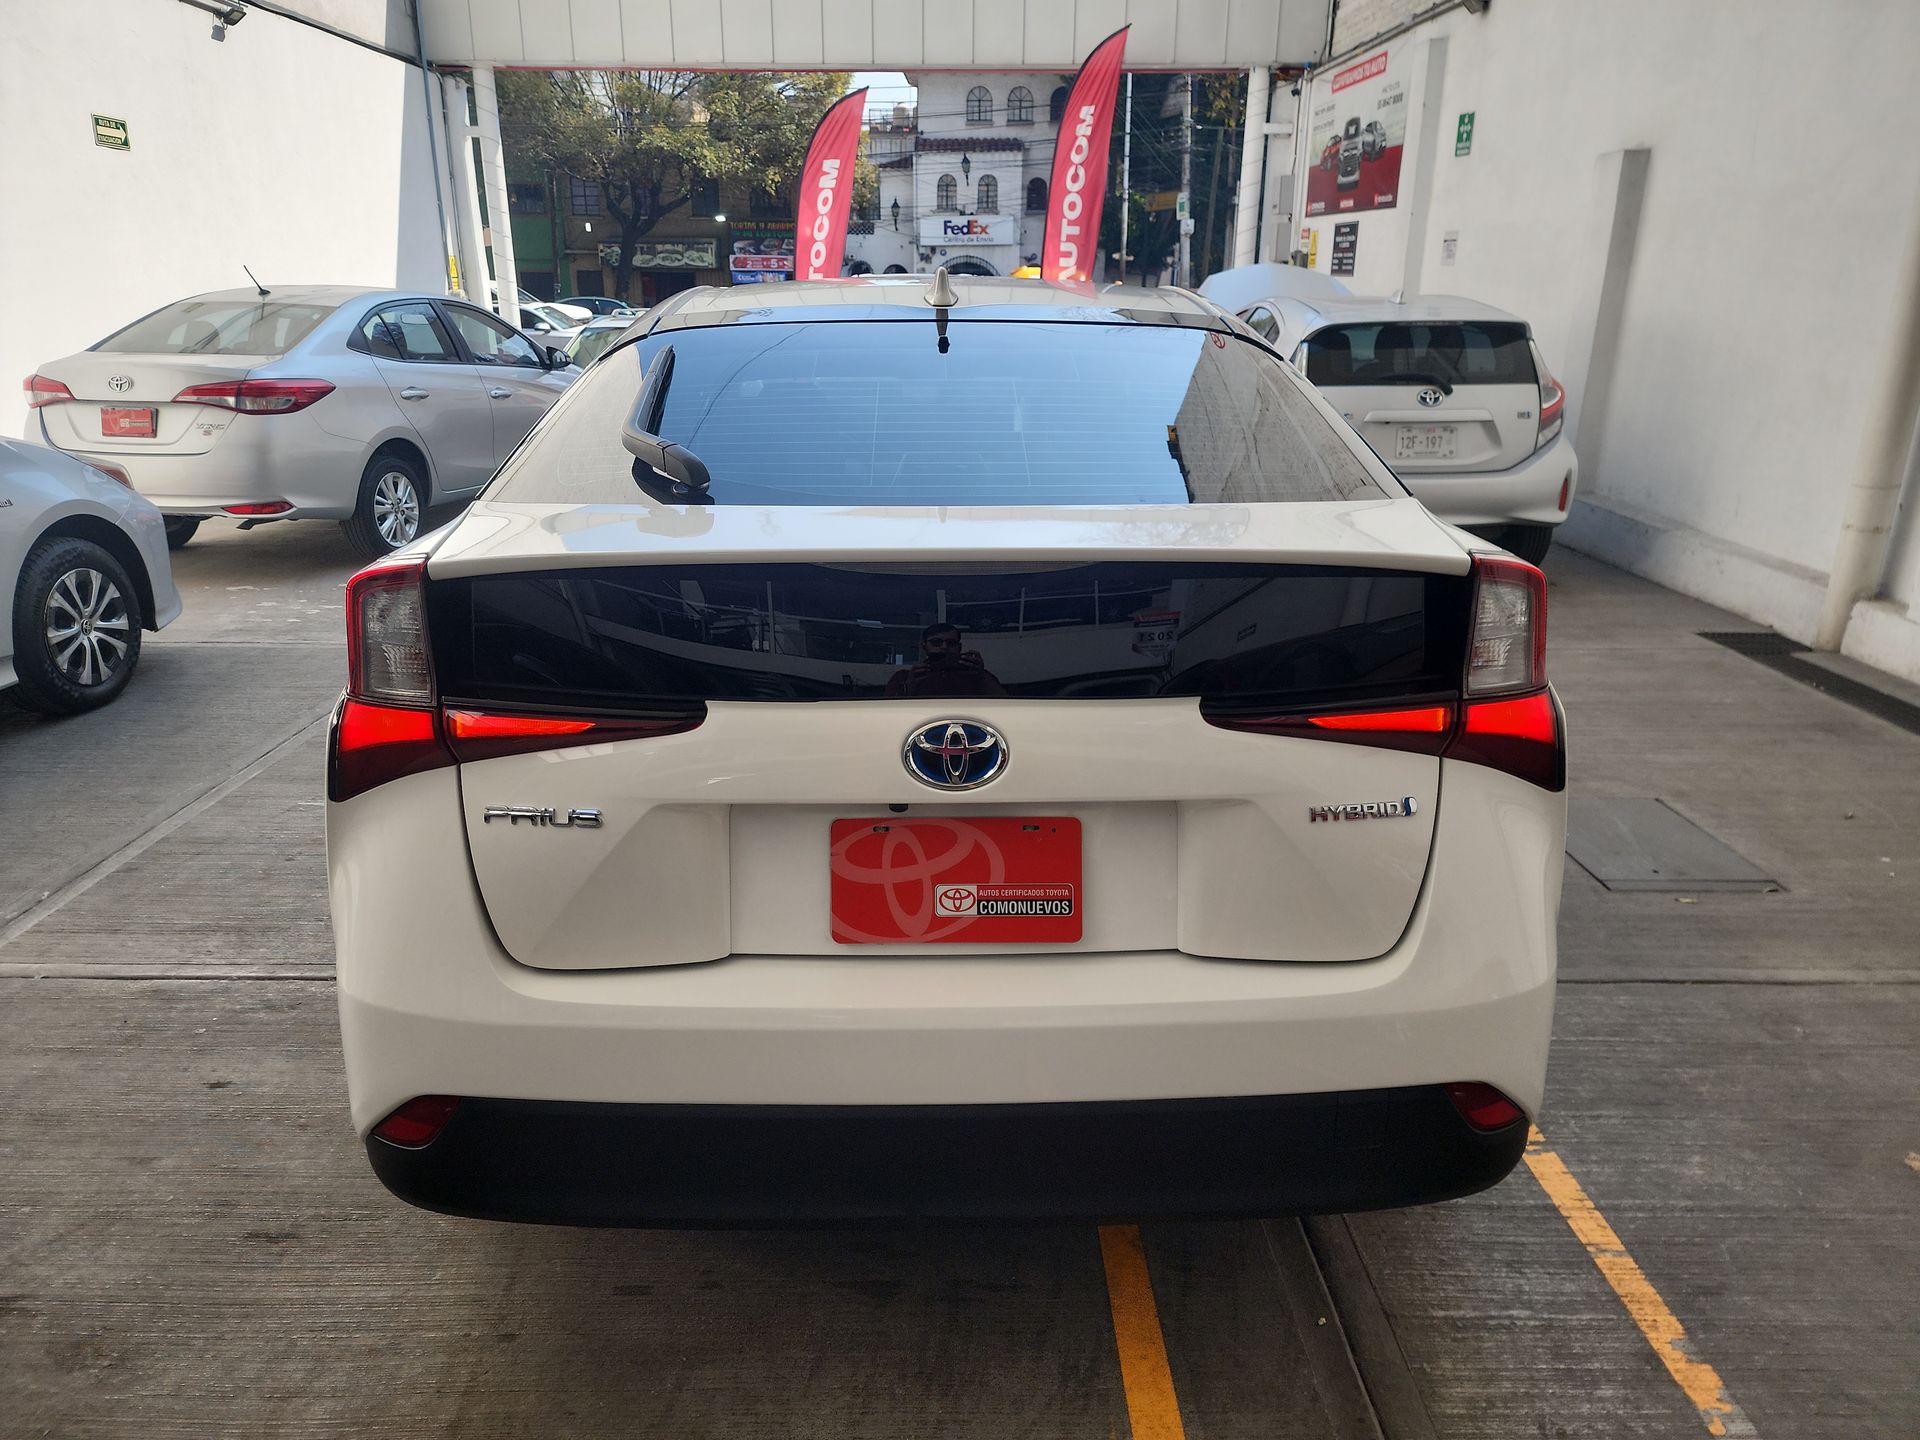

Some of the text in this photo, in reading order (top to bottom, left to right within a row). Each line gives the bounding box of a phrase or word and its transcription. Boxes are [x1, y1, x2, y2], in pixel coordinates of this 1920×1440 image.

[943, 219, 989, 235] FedEx
[484, 804, 603, 828] PRIUS
[1310, 801, 1401, 823] HYBRID
[979, 889, 1070, 897] AUTOS CERTIFICADOS TOYOTA
[979, 900, 1070, 915] COMONUEVOS
